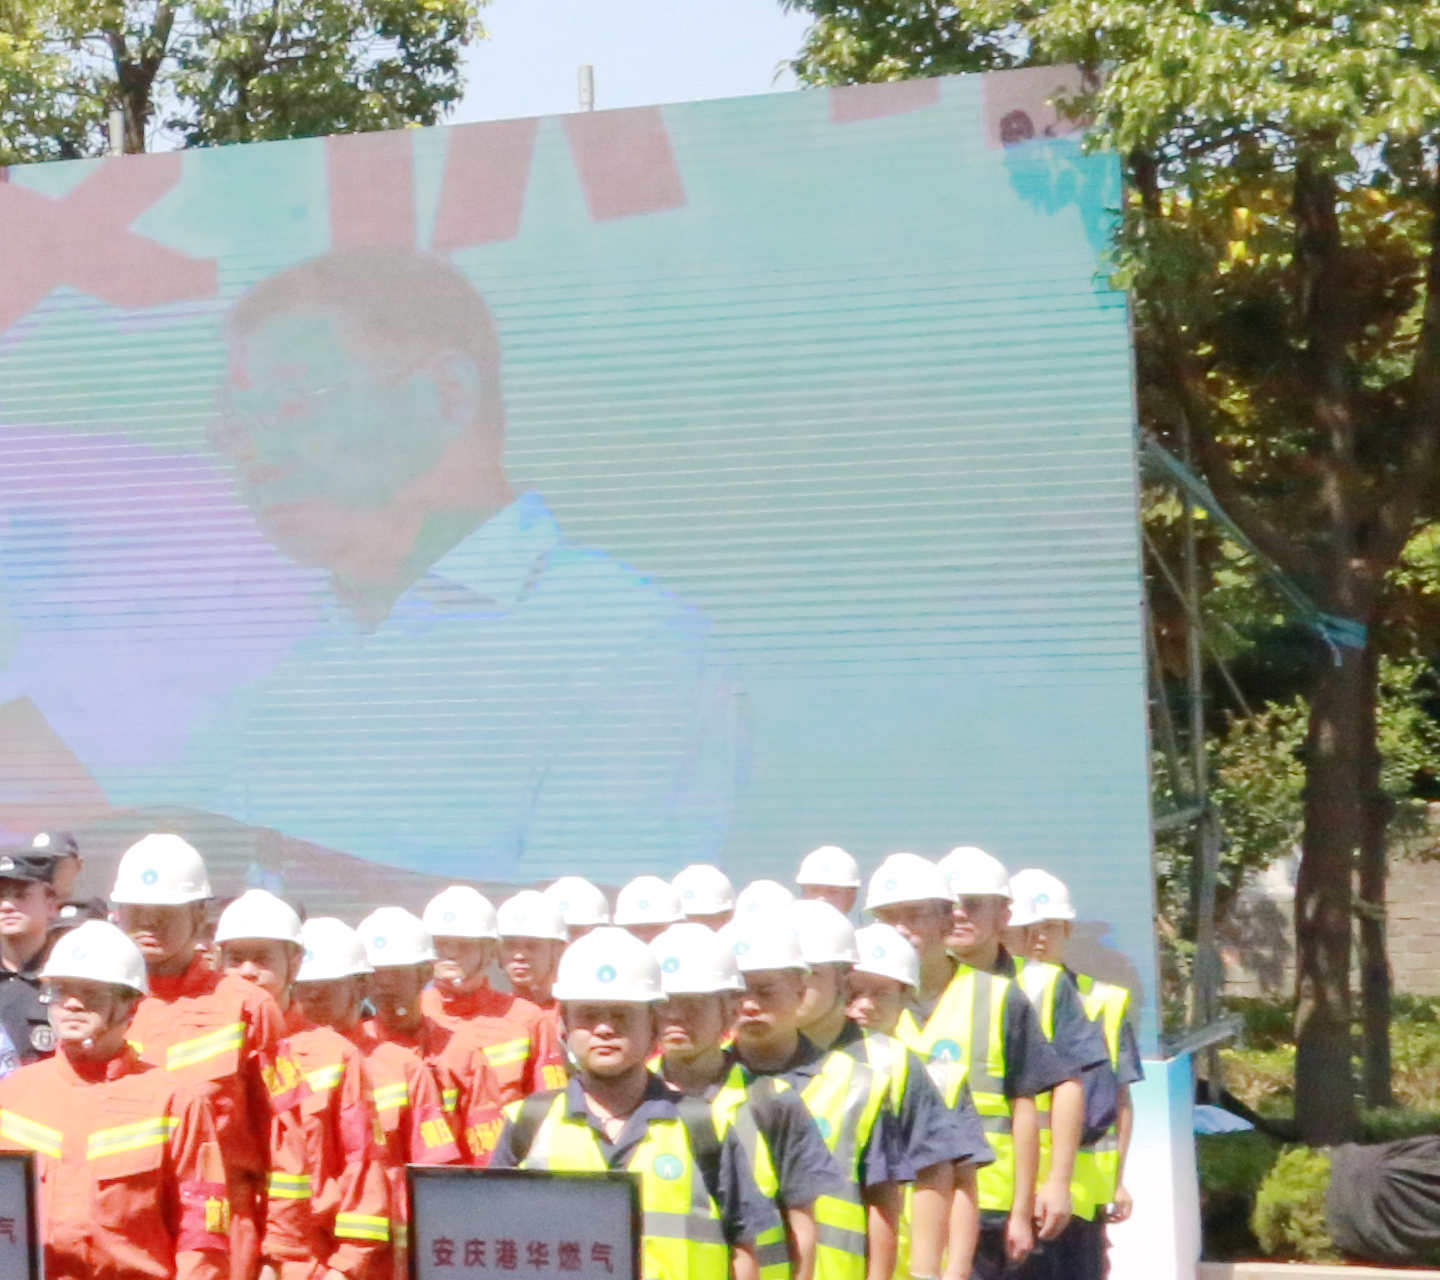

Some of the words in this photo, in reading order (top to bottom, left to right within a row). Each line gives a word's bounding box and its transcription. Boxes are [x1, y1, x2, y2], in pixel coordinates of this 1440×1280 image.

[432, 1236, 614, 1274] 安庆港华燃气
